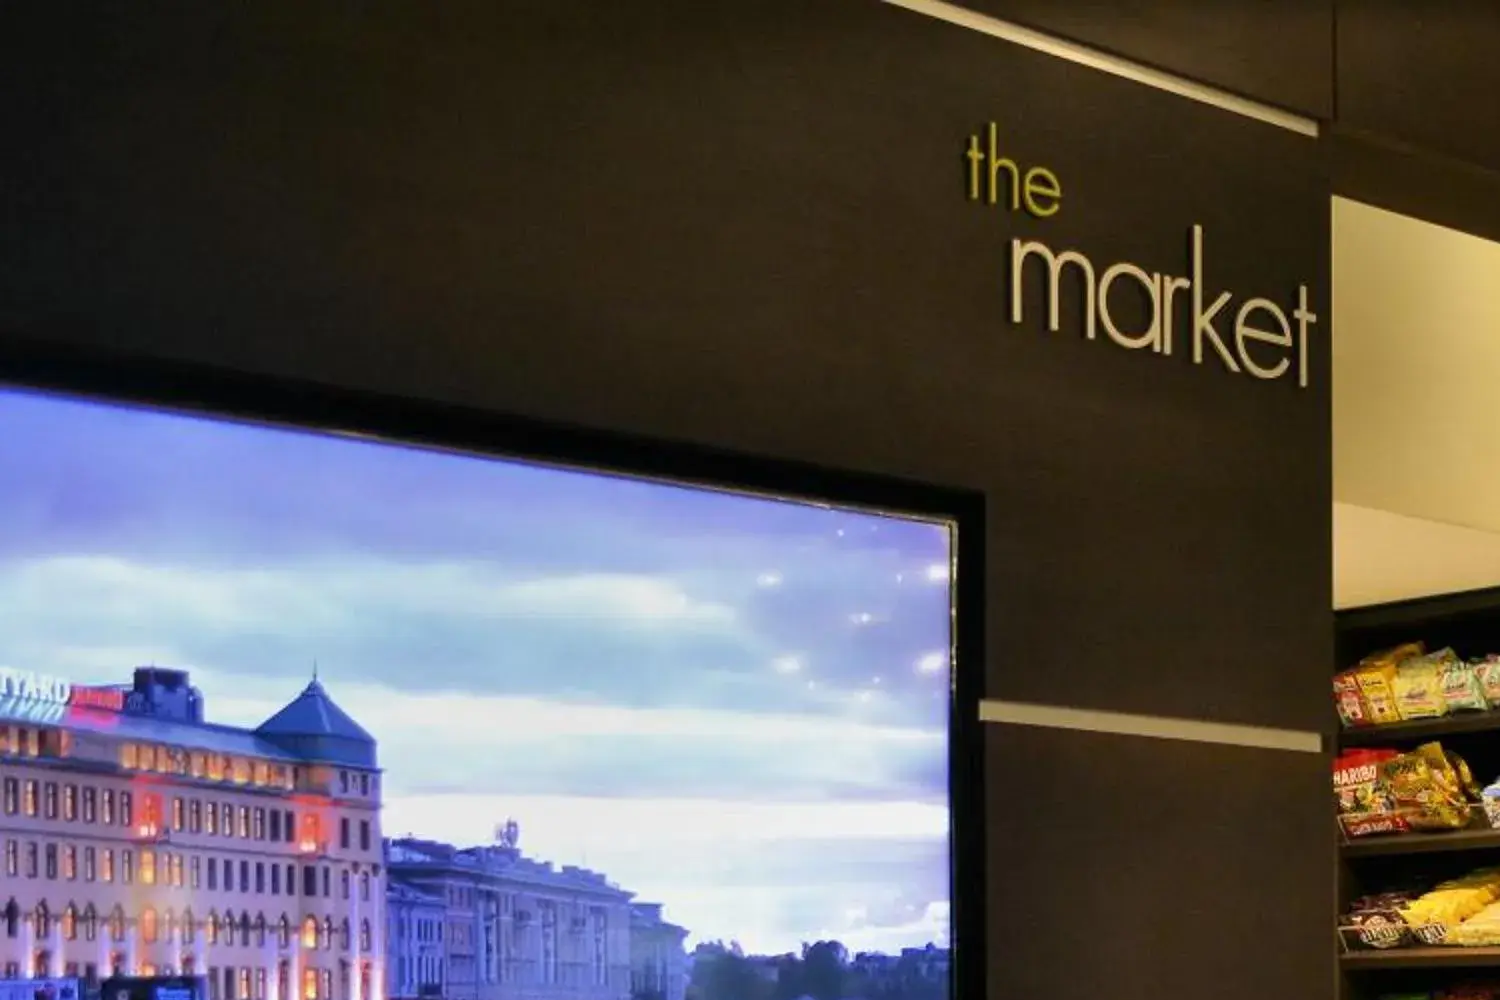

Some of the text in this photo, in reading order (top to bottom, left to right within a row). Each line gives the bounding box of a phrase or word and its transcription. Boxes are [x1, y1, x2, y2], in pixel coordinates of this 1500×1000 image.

[967, 122, 1061, 217] the
[1011, 224, 1317, 388] market
[1333, 764, 1377, 786] HARIBO
